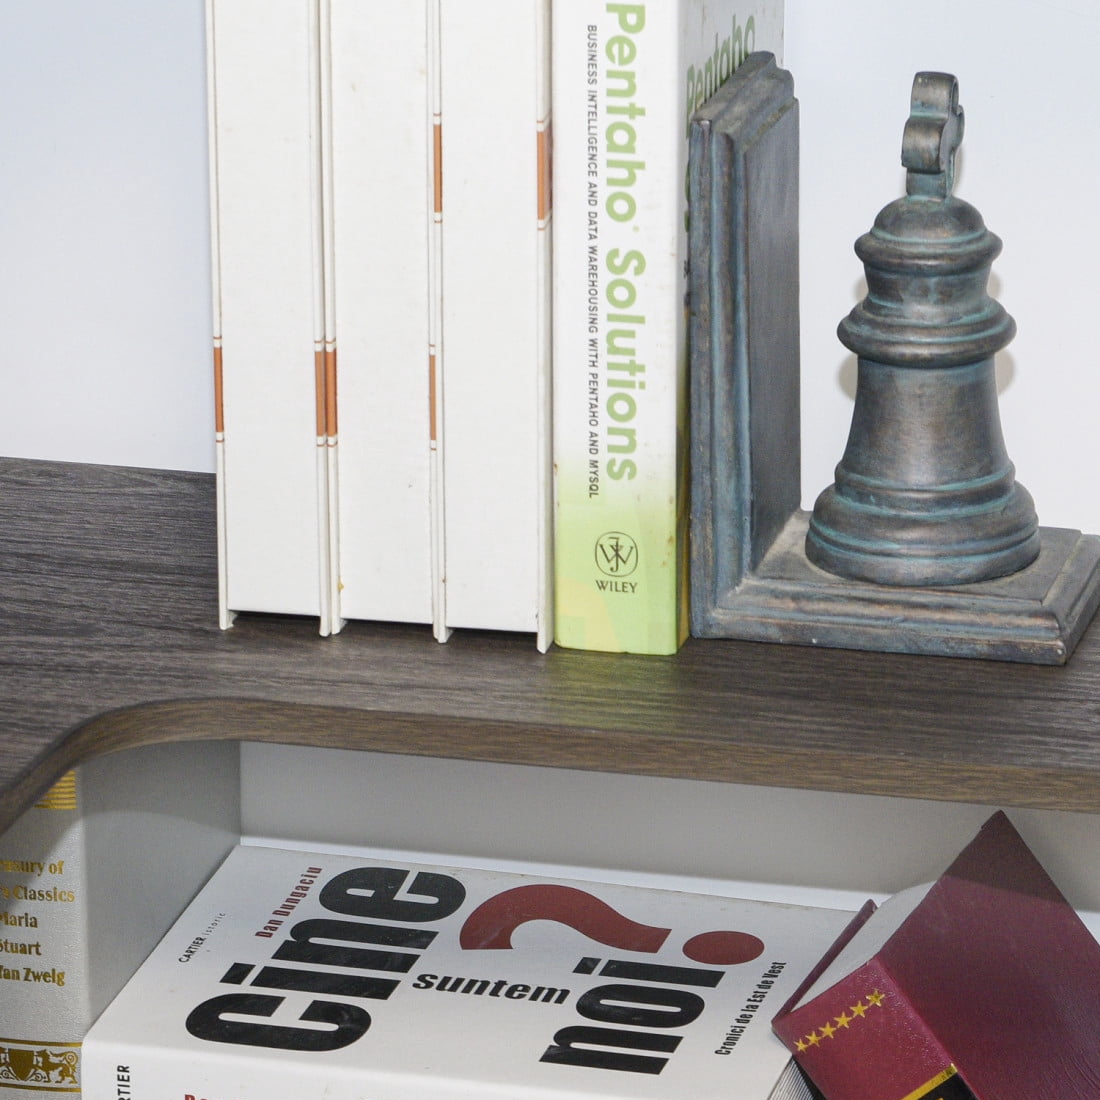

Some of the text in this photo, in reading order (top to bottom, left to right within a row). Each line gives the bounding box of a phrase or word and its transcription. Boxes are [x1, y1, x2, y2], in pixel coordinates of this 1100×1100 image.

[605, 3, 647, 482] Pentaho Solutions
[587, 24, 600, 500] BUSINESS INTELLIGENCE AND DATA WAREHOUSING WITH PENTAHO AND MYSQL
[595, 579, 638, 594] WILEY
[48, 860, 65, 875] of
[12, 885, 76, 903] Classics
[255, 866, 324, 939] Dan Dungaciu
[178, 936, 207, 964] CARTIER
[184, 866, 468, 1053] Cine
[22, 967, 67, 987] Zweig
[412, 971, 572, 1006] suntem
[714, 961, 788, 1056] Cronici de la Est de Vest
